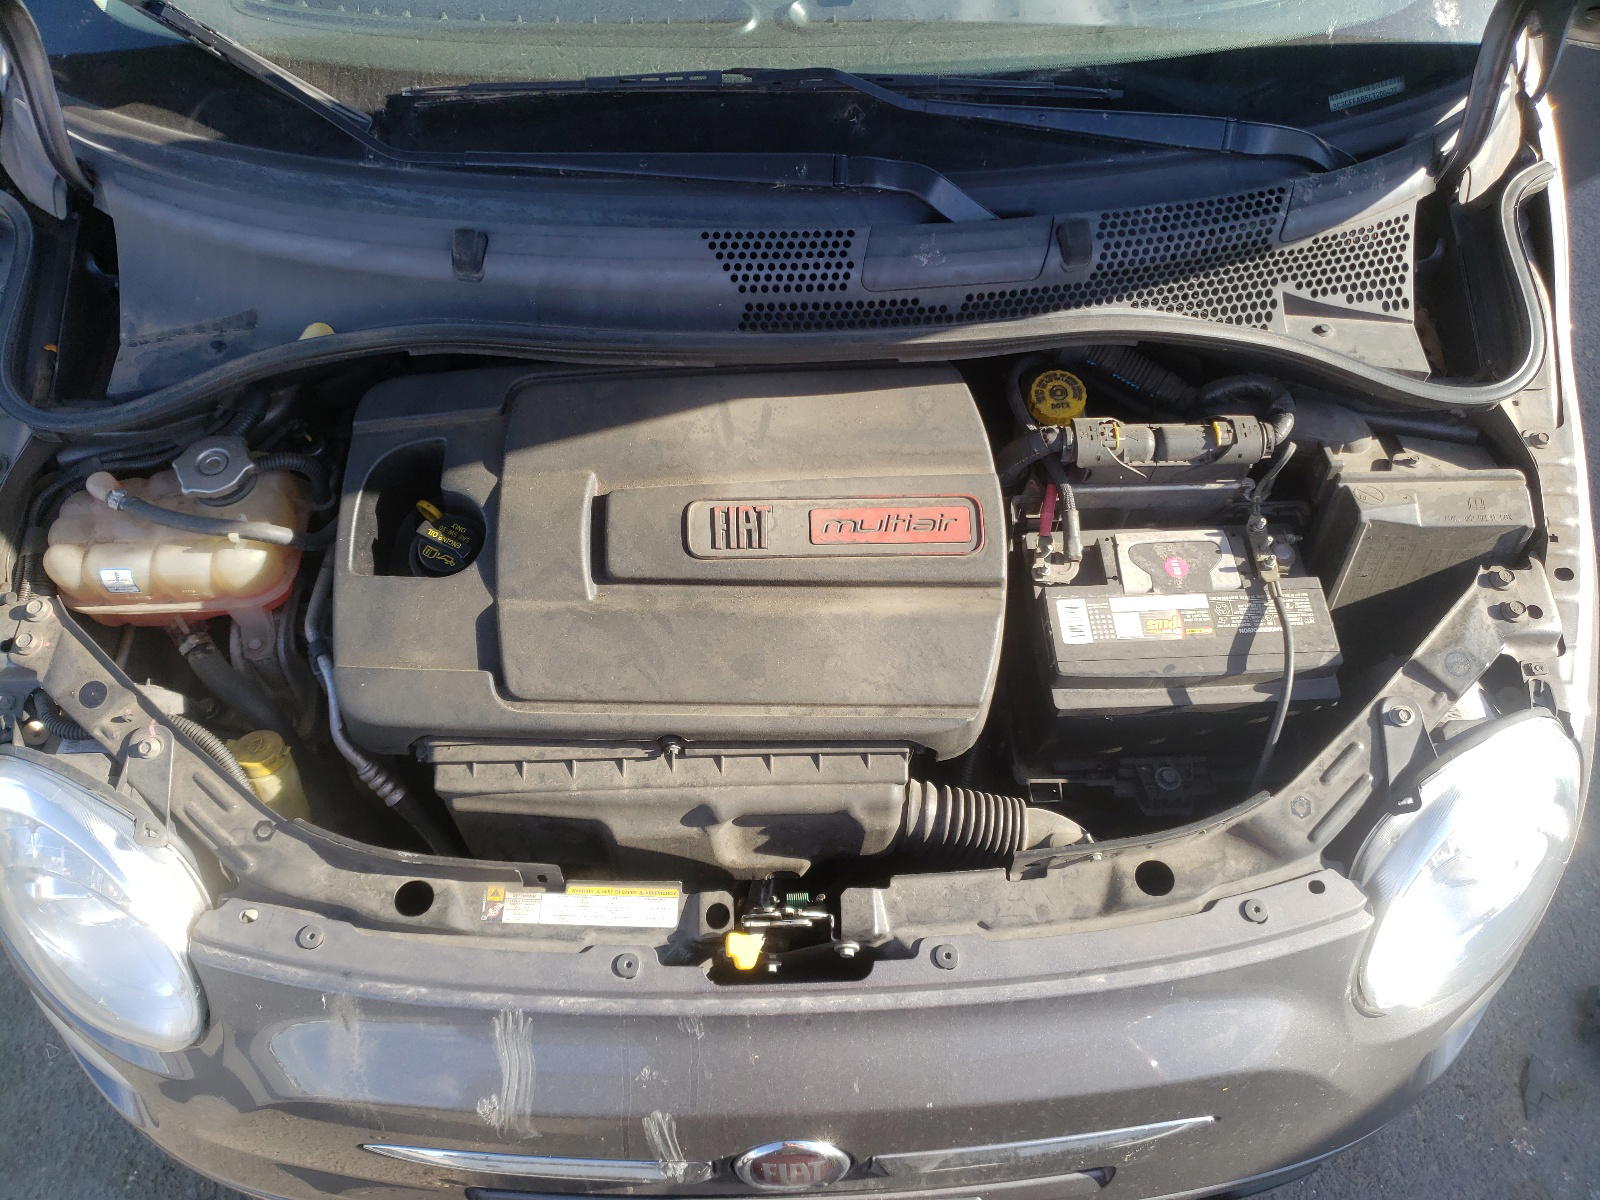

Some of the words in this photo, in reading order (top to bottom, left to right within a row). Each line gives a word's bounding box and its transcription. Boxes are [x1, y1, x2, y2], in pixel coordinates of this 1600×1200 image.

[427, 528, 438, 537] OIL
[710, 505, 772, 549] FIAT
[822, 514, 958, 534] multiair
[761, 1161, 826, 1181] FIAT
